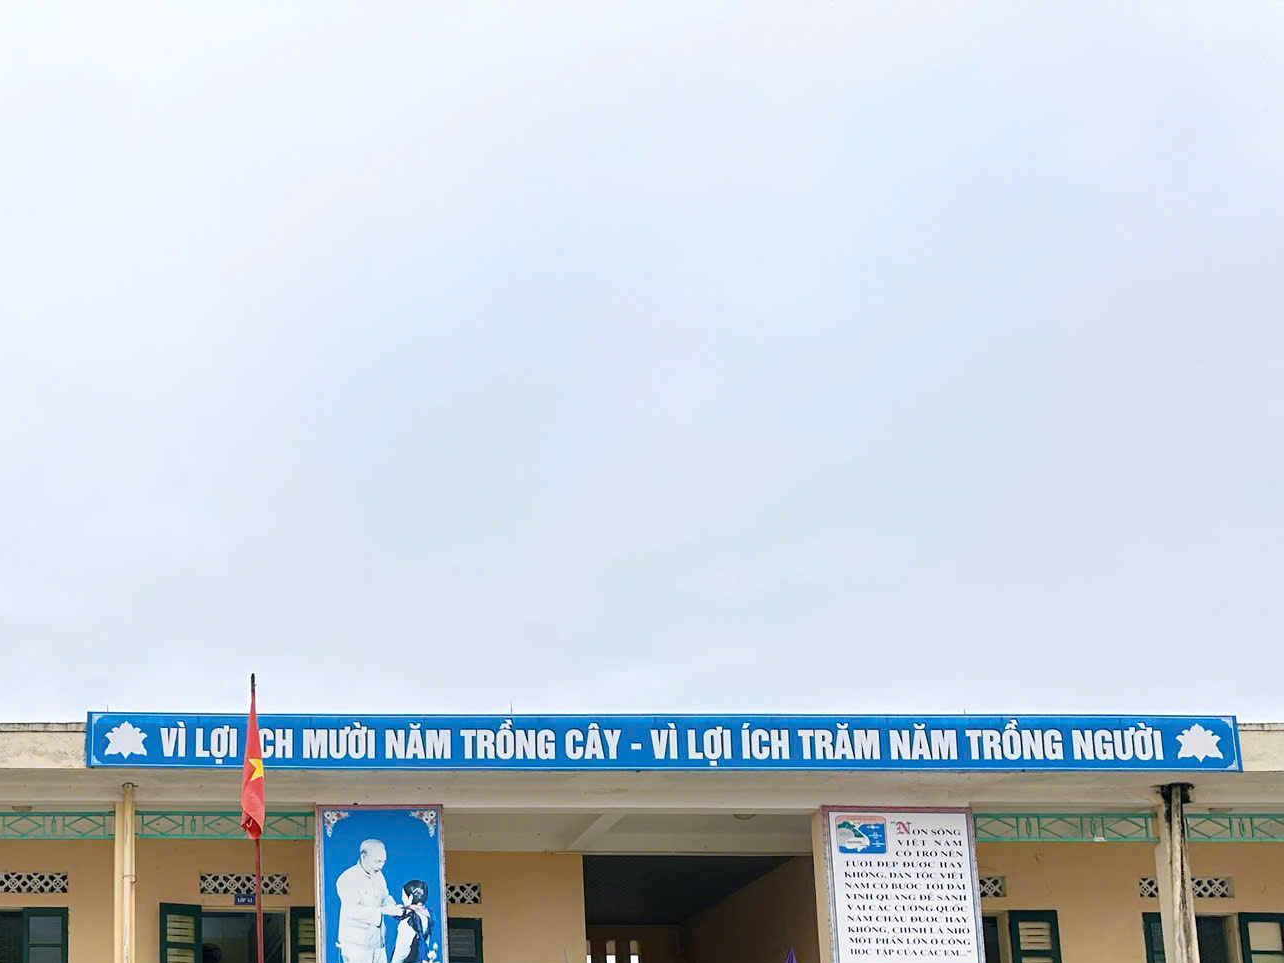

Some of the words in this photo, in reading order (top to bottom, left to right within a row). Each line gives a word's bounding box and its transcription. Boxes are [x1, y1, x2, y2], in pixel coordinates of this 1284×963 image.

[160, 721, 186, 757] VÌ
[195, 725, 237, 764] LỢI
[258, 728, 293, 759] CH
[302, 722, 376, 759] MƯỜI
[385, 724, 452, 759] NĂM
[460, 719, 556, 760] TRỒNG
[565, 722, 622, 760] CÂY
[650, 722, 678, 760] VÌ
[687, 726, 732, 766] LỢI
[741, 722, 790, 760] ÍCH
[797, 723, 881, 760] TRĂM
[889, 724, 958, 760] NĂM
[965, 718, 1064, 760] TRỒNG
[1071, 722, 1164, 760] NGƯỜI
[934, 839, 963, 847] NAM
[939, 861, 964, 869] HAY
[845, 892, 874, 900] VINH
[875, 893, 916, 901] QUANG
[846, 903, 866, 911] VAI
[945, 915, 969, 923] HAY
